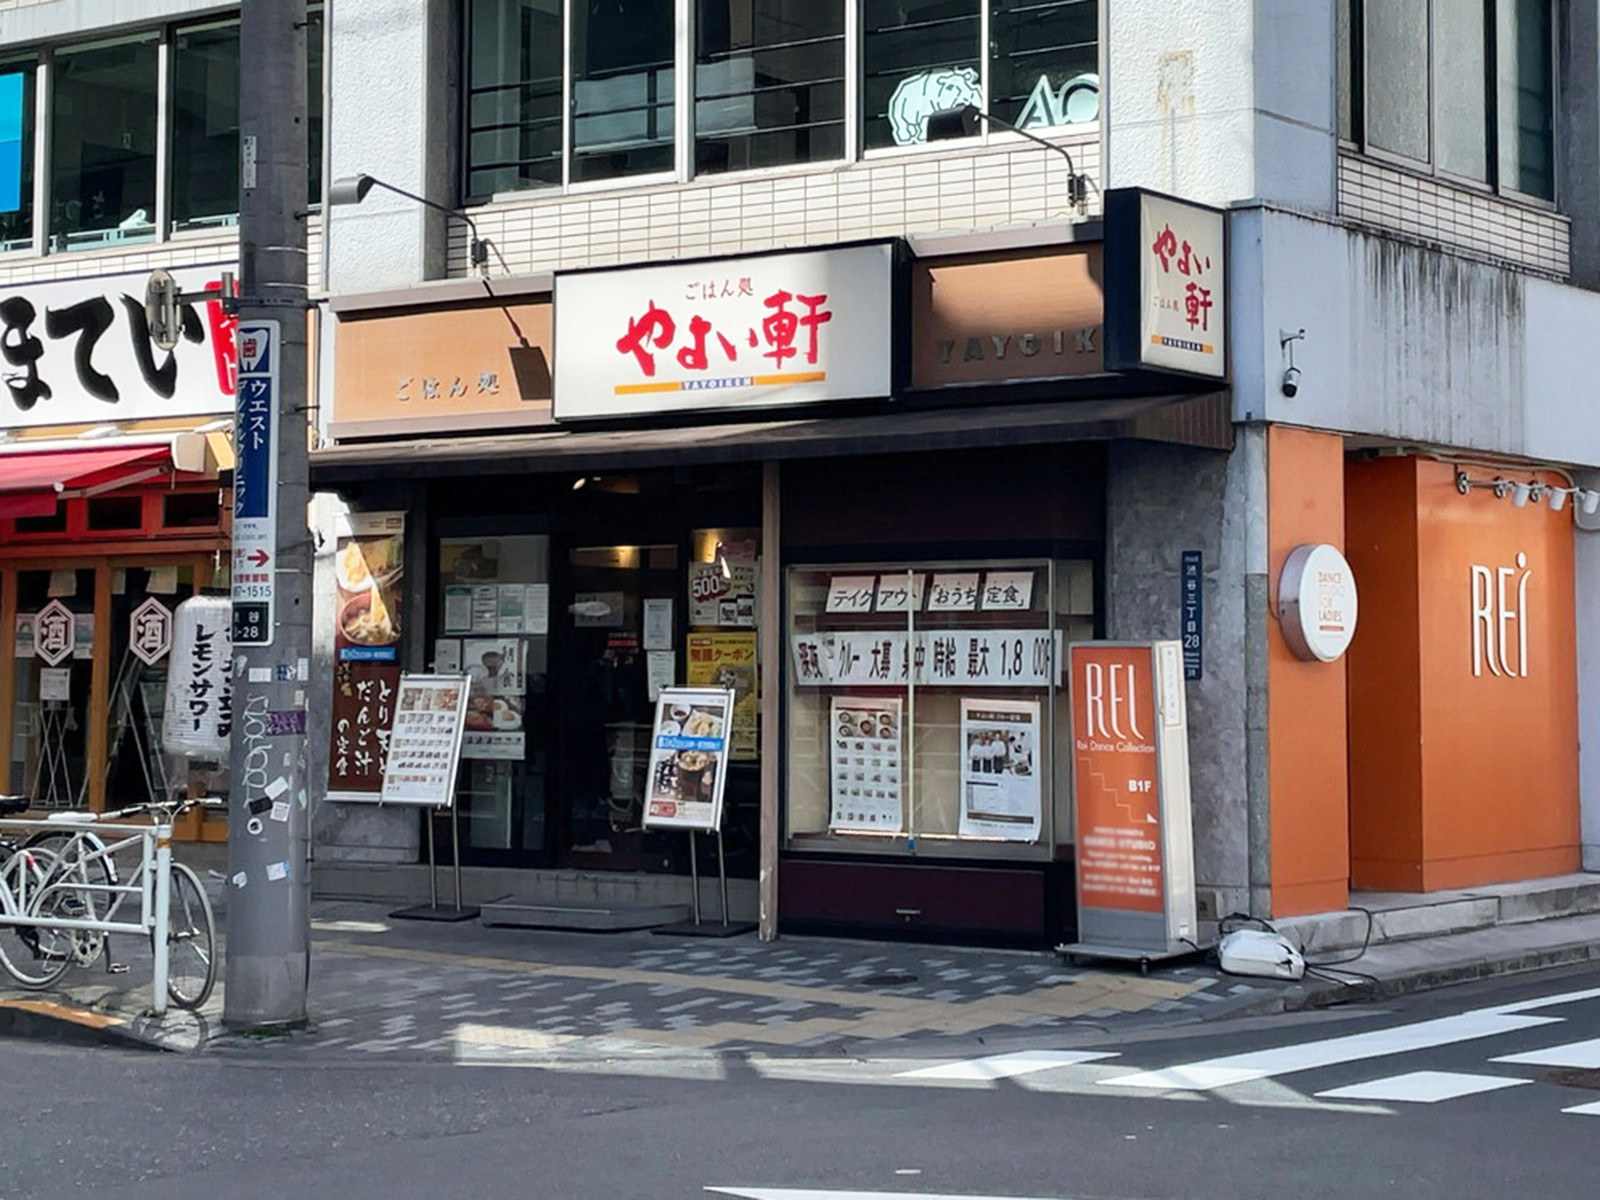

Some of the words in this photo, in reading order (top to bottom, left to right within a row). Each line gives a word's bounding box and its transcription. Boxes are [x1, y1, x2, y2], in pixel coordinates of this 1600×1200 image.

[685, 277, 754, 300] ごはん処
[616, 289, 832, 377] やよい軒
[248, 380, 268, 449] ウエスト
[189, 624, 216, 731] レモンサワー
[1128, 780, 1152, 793] B1F
